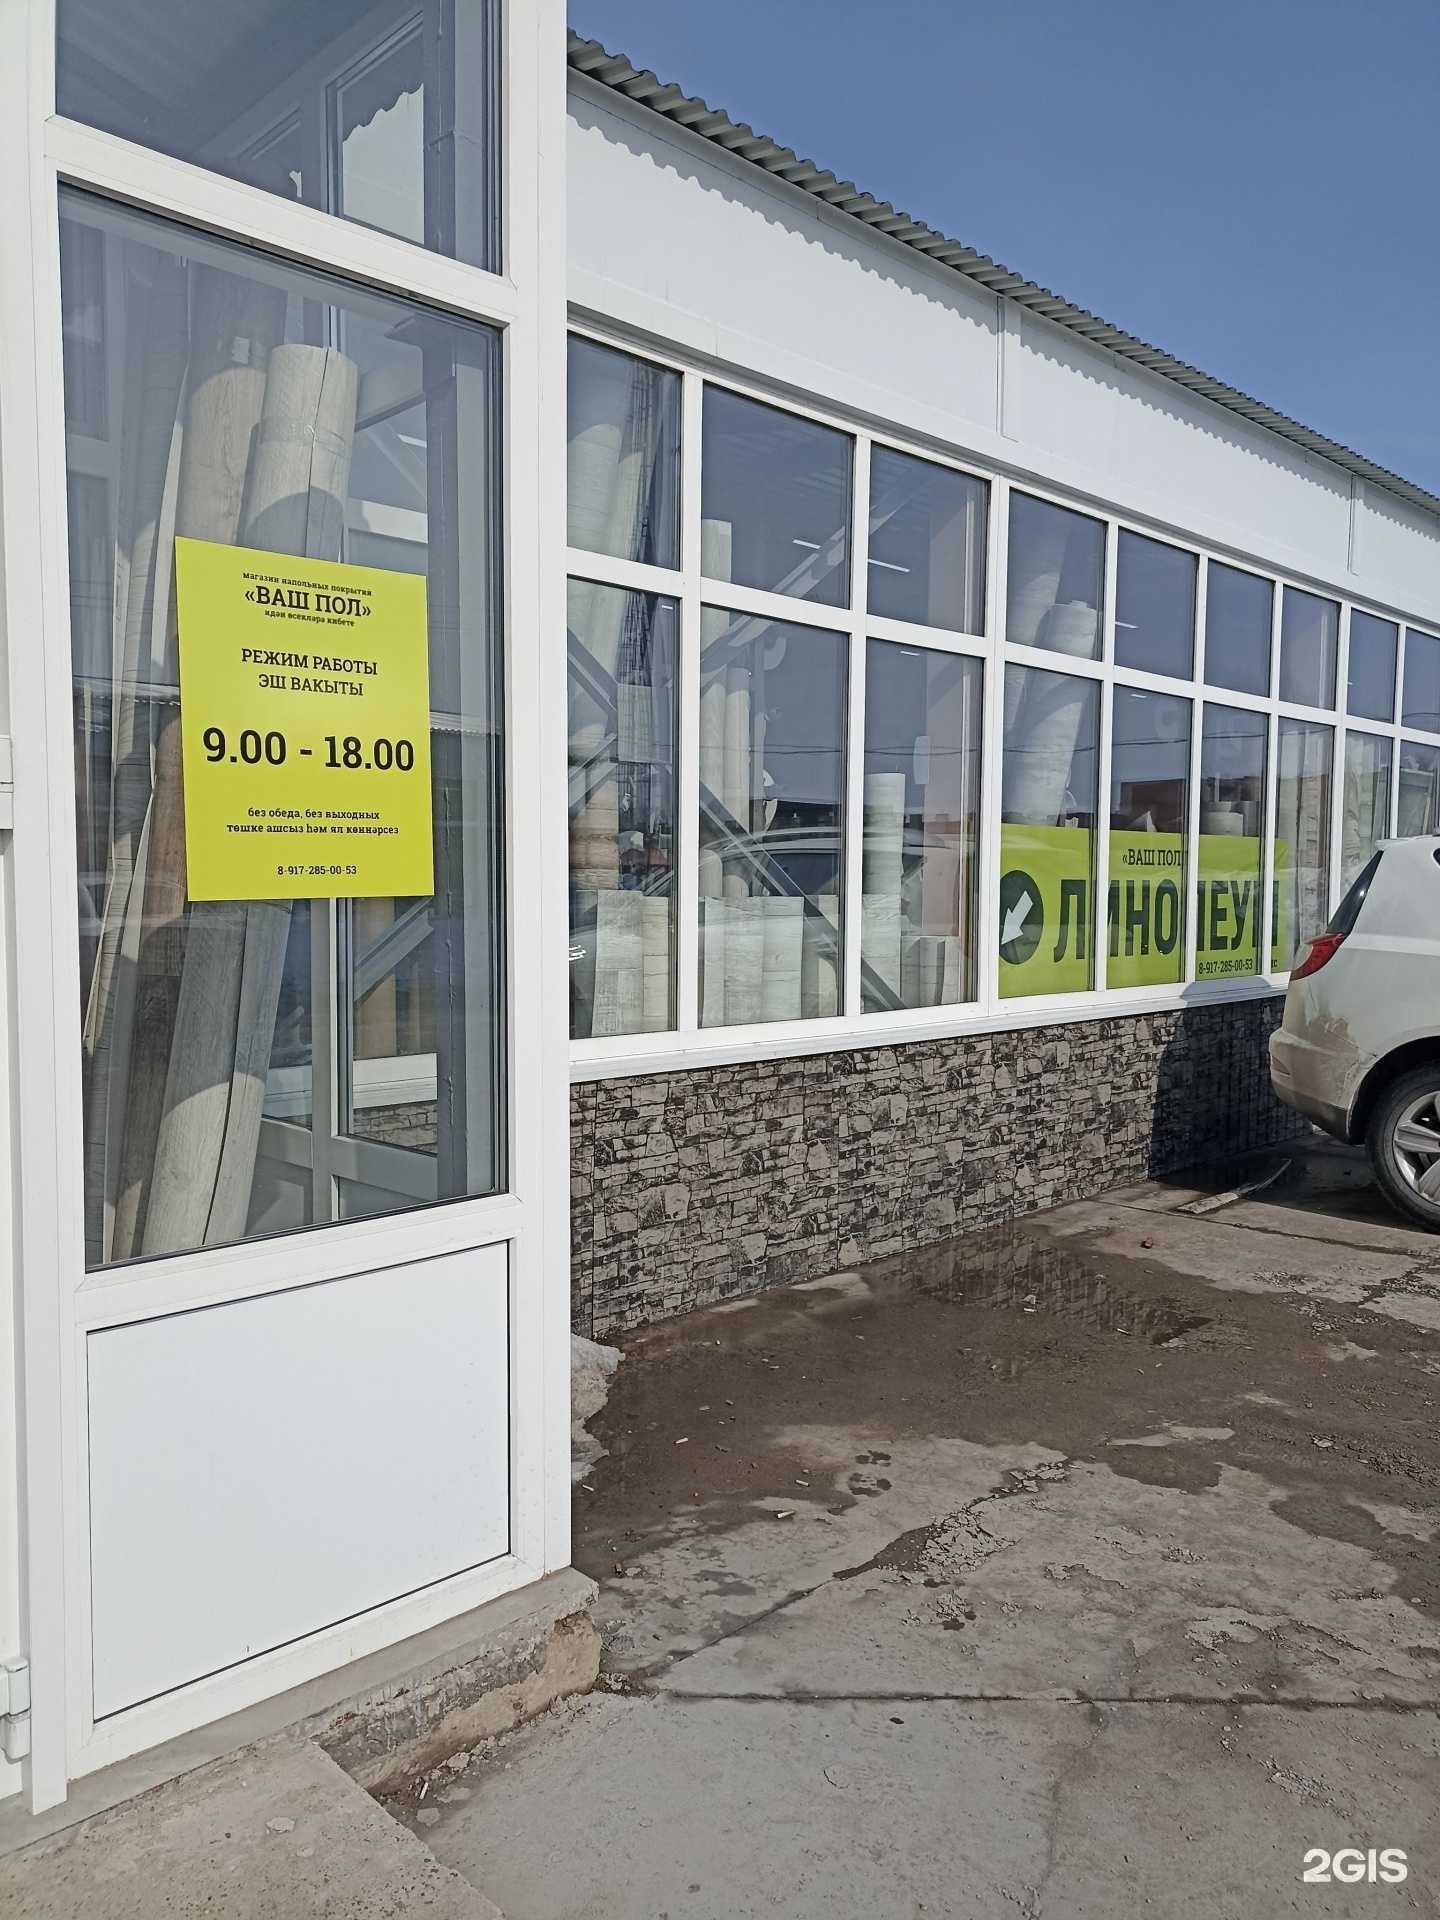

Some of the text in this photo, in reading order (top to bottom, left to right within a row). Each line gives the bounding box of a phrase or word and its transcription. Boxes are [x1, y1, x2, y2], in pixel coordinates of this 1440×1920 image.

[243, 572, 279, 584] магазин
[282, 578, 329, 590] напольных
[244, 585, 372, 617] «ВАШ ПОЛ»
[241, 648, 378, 675] РЕЖИМ РАБОТЫ
[258, 673, 364, 696] ЭШ ВАКЫТЫ
[203, 727, 287, 765] 9.00
[324, 735, 414, 771] 18.00
[247, 807, 380, 821] без обеда, без выходных
[226, 823, 264, 833] төшке
[266, 824, 304, 833] ашсыз
[330, 825, 344, 834] ял
[1122, 849, 1155, 866] «ВАШ
[277, 865, 357, 875] 8-917-285-00-53
[1198, 959, 1253, 974] 8-917-285-00-53
